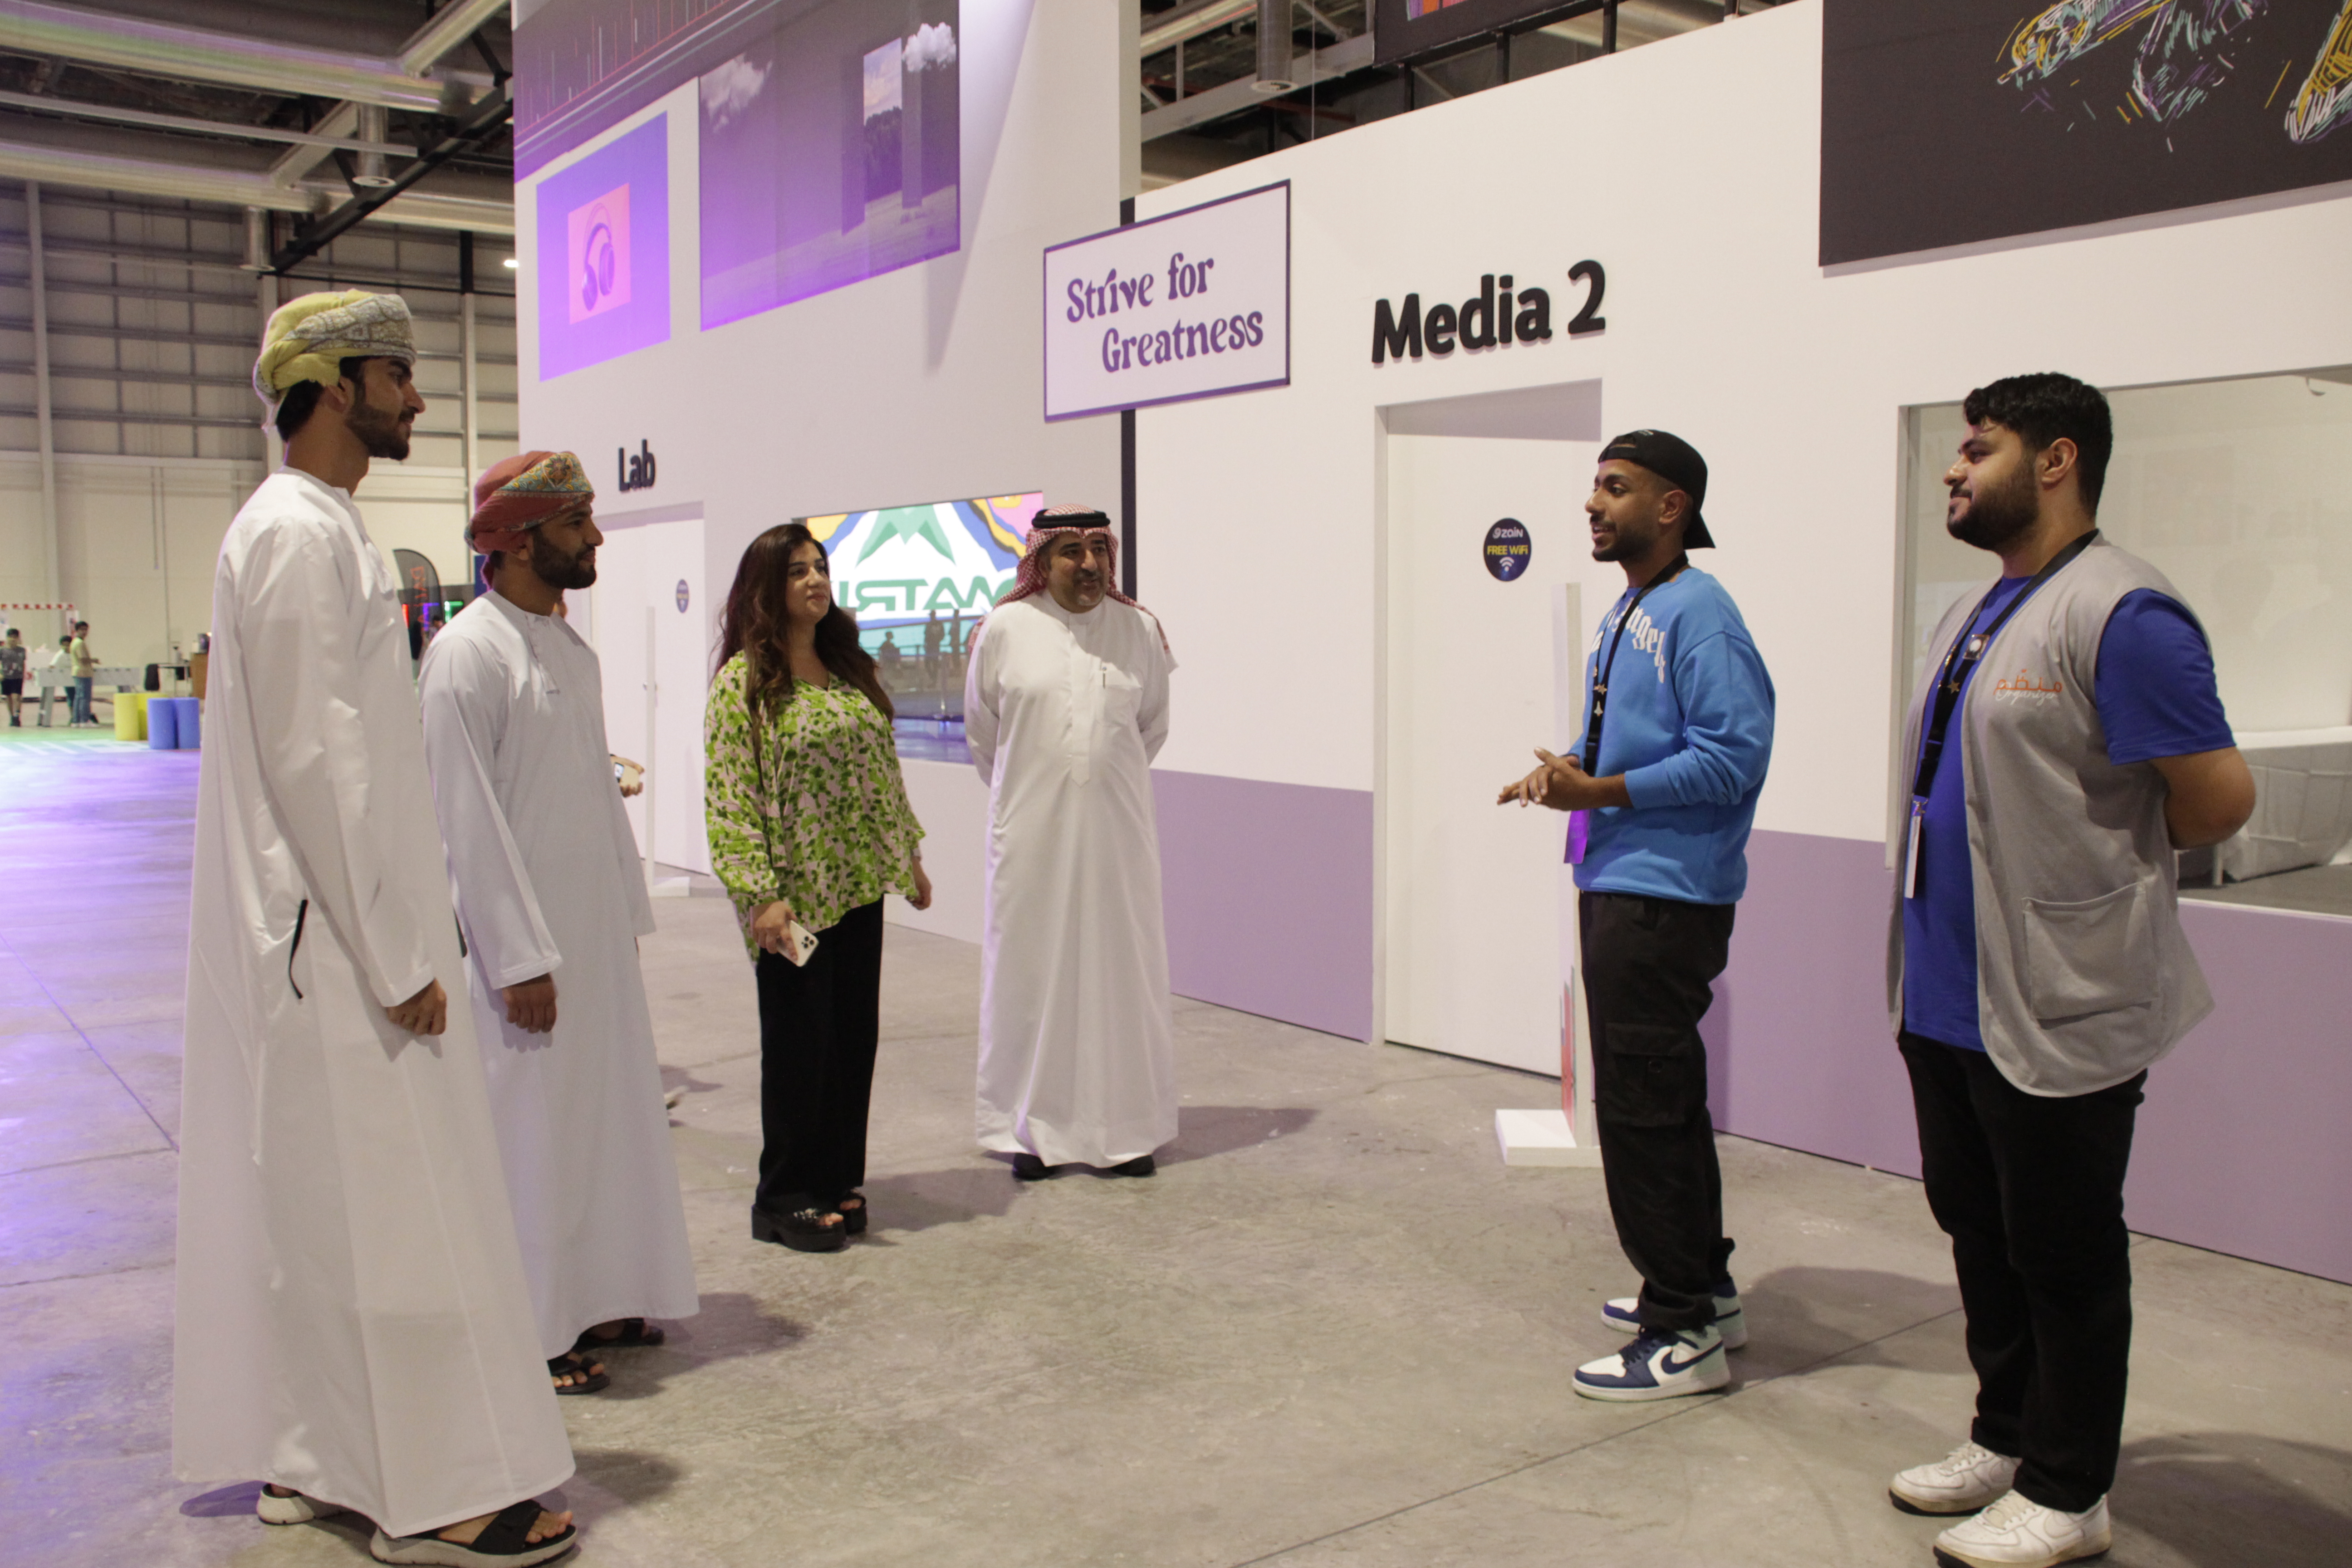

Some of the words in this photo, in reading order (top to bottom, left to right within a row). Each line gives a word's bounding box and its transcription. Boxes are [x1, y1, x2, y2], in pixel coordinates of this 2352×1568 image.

[1067, 268, 1154, 322] Strive
[1168, 253, 1214, 300] for
[1372, 274, 1553, 364] Media
[1568, 260, 1606, 334] 2
[1102, 311, 1264, 373] Greatness
[618, 439, 656, 491] Lab
[1487, 545, 1508, 555] FREE
